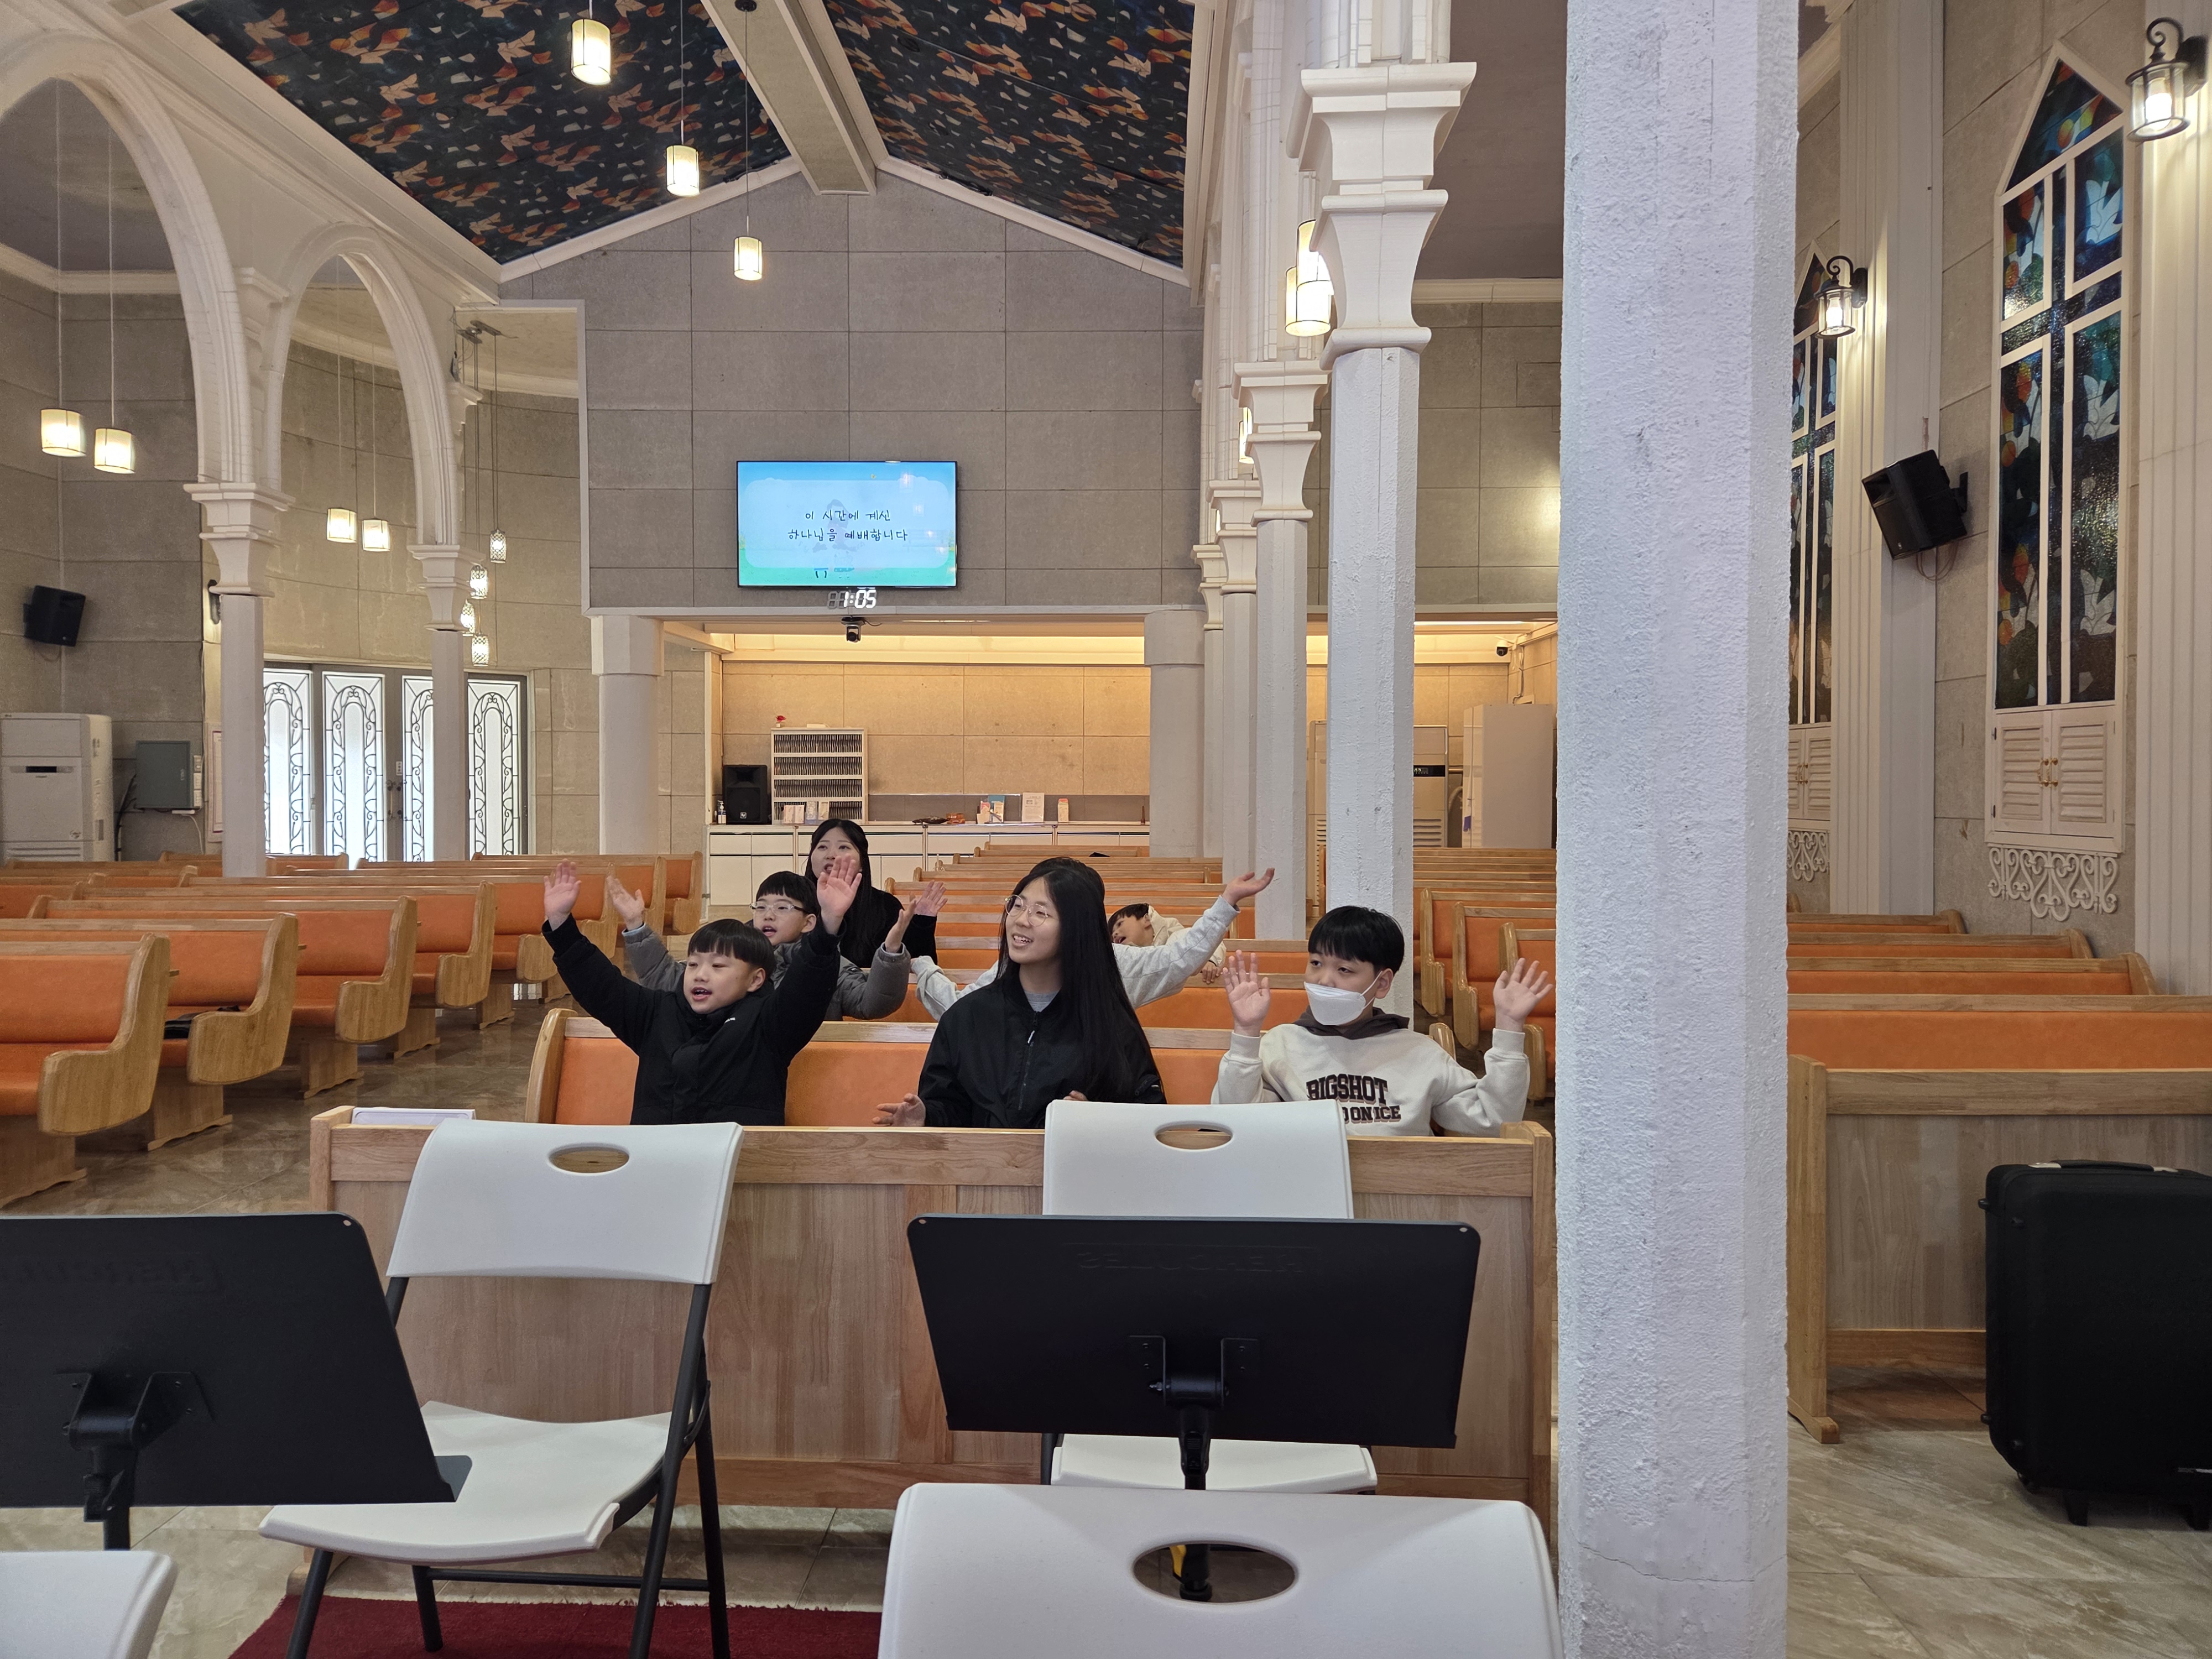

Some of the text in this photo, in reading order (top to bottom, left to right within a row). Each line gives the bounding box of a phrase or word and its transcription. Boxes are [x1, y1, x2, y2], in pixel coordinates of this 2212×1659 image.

[805, 509, 891, 521] 이 시간에 계신
[787, 528, 908, 542] 하나님을 예배합니다
[1306, 1073, 1389, 1107] BIGSHOT
